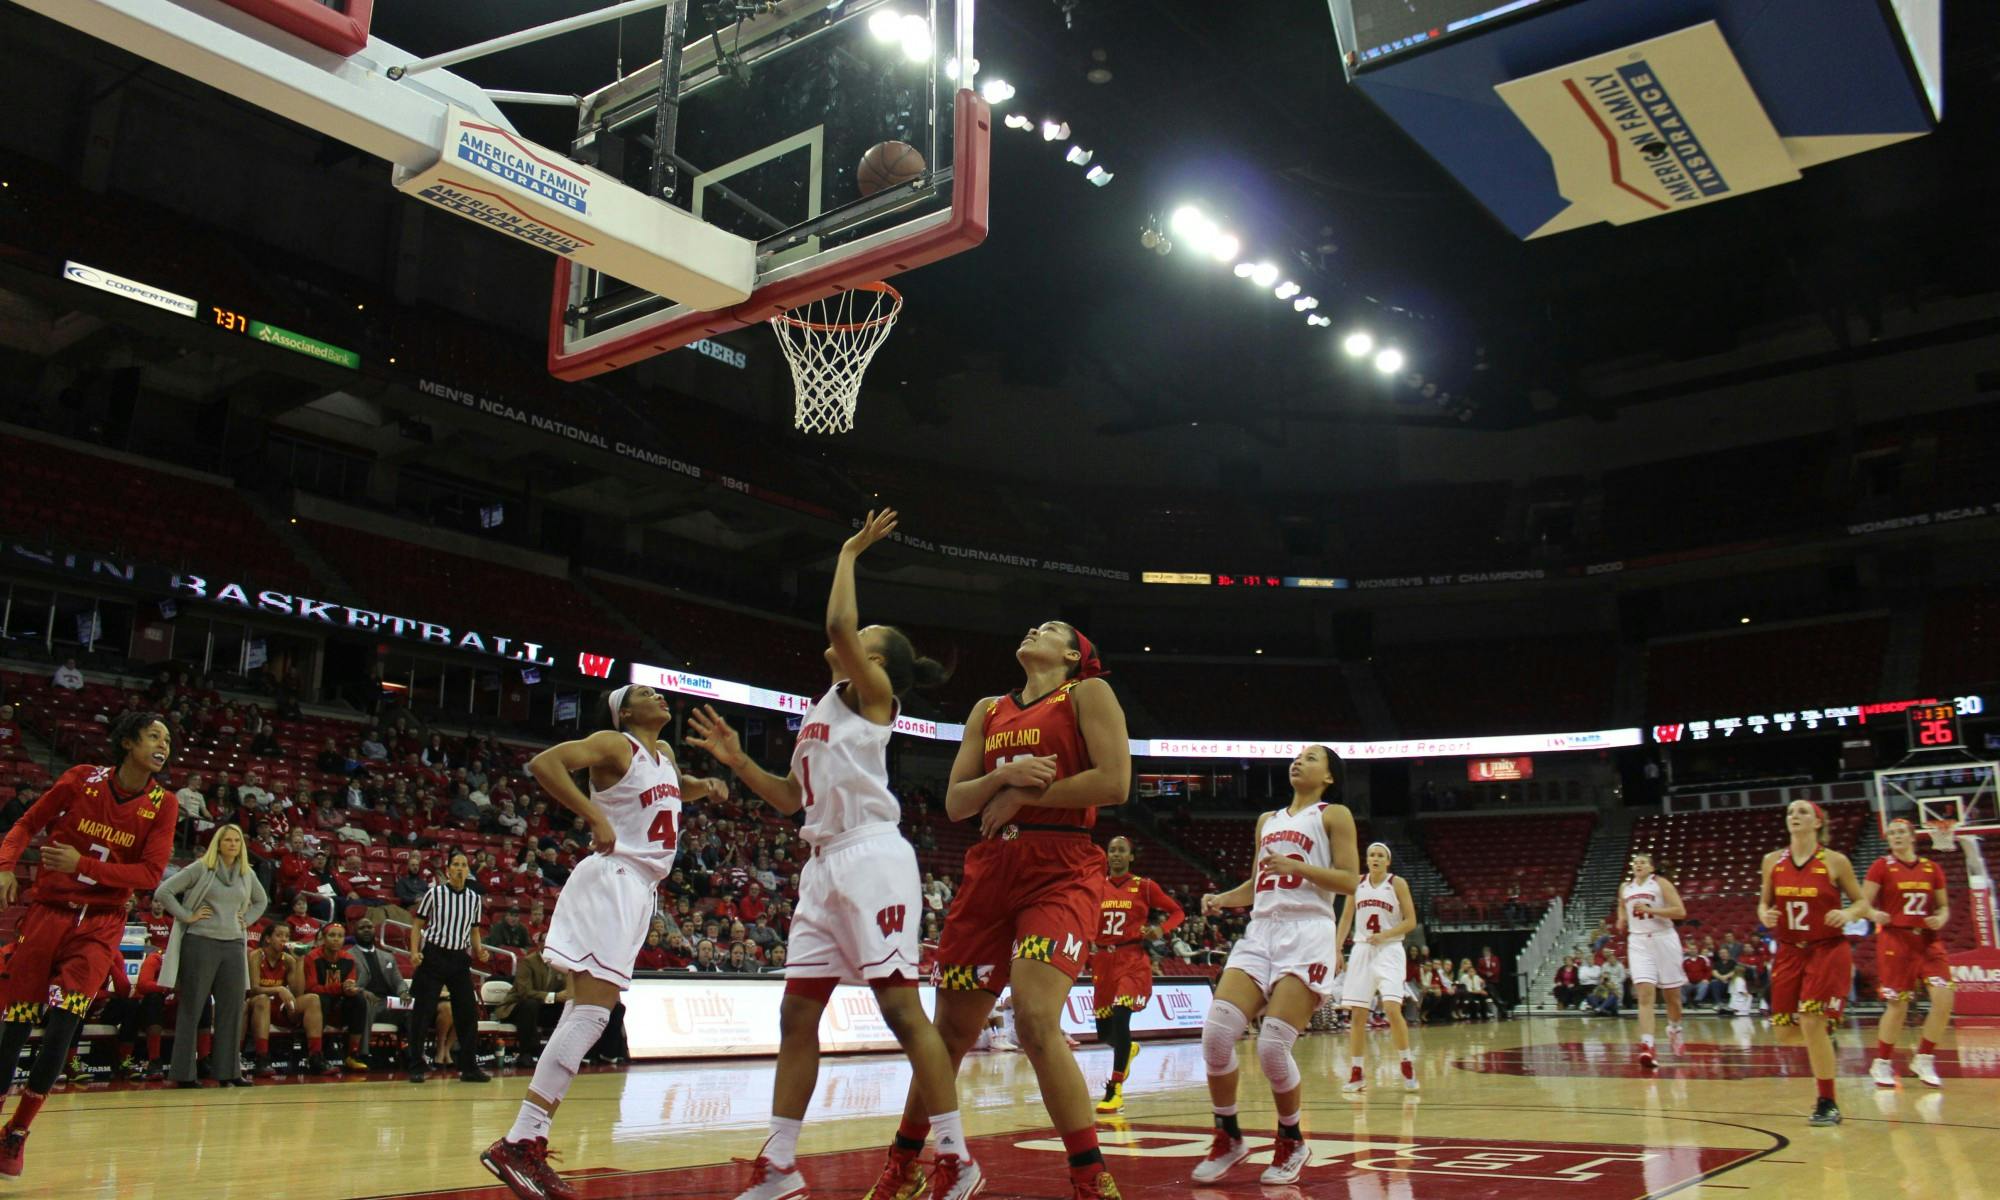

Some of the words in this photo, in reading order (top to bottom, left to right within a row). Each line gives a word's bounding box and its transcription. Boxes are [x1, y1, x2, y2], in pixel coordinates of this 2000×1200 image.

[1584, 73, 1648, 132] FAMILY
[1629, 72, 1720, 189] INSURANCE
[460, 131, 535, 177] AMERICAN
[540, 170, 588, 199] FAMILY
[468, 151, 577, 207] INSURANCE
[429, 184, 522, 224] AMERICAN
[525, 223, 585, 250] FAMILY
[431, 194, 562, 250] INSURANCE
[212, 306, 247, 333] 7:37
[418, 378, 475, 407] MEN'S
[479, 398, 528, 424] NCAA
[531, 414, 609, 449] NATIONAL
[615, 441, 702, 478] CHAMPIONS
[721, 475, 750, 494] 1941
[1847, 512, 1932, 536] WOMEN'S
[1934, 506, 1987, 523] NCAA
[904, 535, 935, 552] NCAA
[939, 543, 1038, 569] TOURNAMENT
[1042, 558, 1131, 582] APPEARANCES
[1355, 576, 1423, 590] WOMEN'S
[1429, 574, 1453, 586] NIT
[1458, 569, 1545, 584] CHAMPIONS
[1585, 561, 1624, 576] 2000
[170, 574, 555, 667] BASKETBALL
[577, 651, 616, 679] W
[778, 695, 794, 710] #1
[1953, 696, 1982, 715] 30
[892, 719, 935, 736] consin
[1920, 719, 1953, 745] 26
[1160, 742, 1218, 754] Ranked
[1226, 743, 1241, 753] #1
[1249, 743, 1266, 756] by
[1274, 744, 1293, 754] US
[1364, 743, 1409, 755] World
[1416, 741, 1471, 755] Report
[801, 755, 815, 807] 1
[76, 817, 136, 848] MARYLAND
[1785, 900, 1811, 932] 12
[1902, 892, 1929, 916] 22
[876, 903, 906, 939] W
[1102, 910, 1127, 936] 32
[1366, 913, 1382, 935] 4
[1062, 932, 1083, 963] M
[1307, 962, 1329, 985] W
[662, 989, 736, 1036] Unity
[1065, 988, 1095, 1025] Uni
[1156, 988, 1193, 1022] Unity
